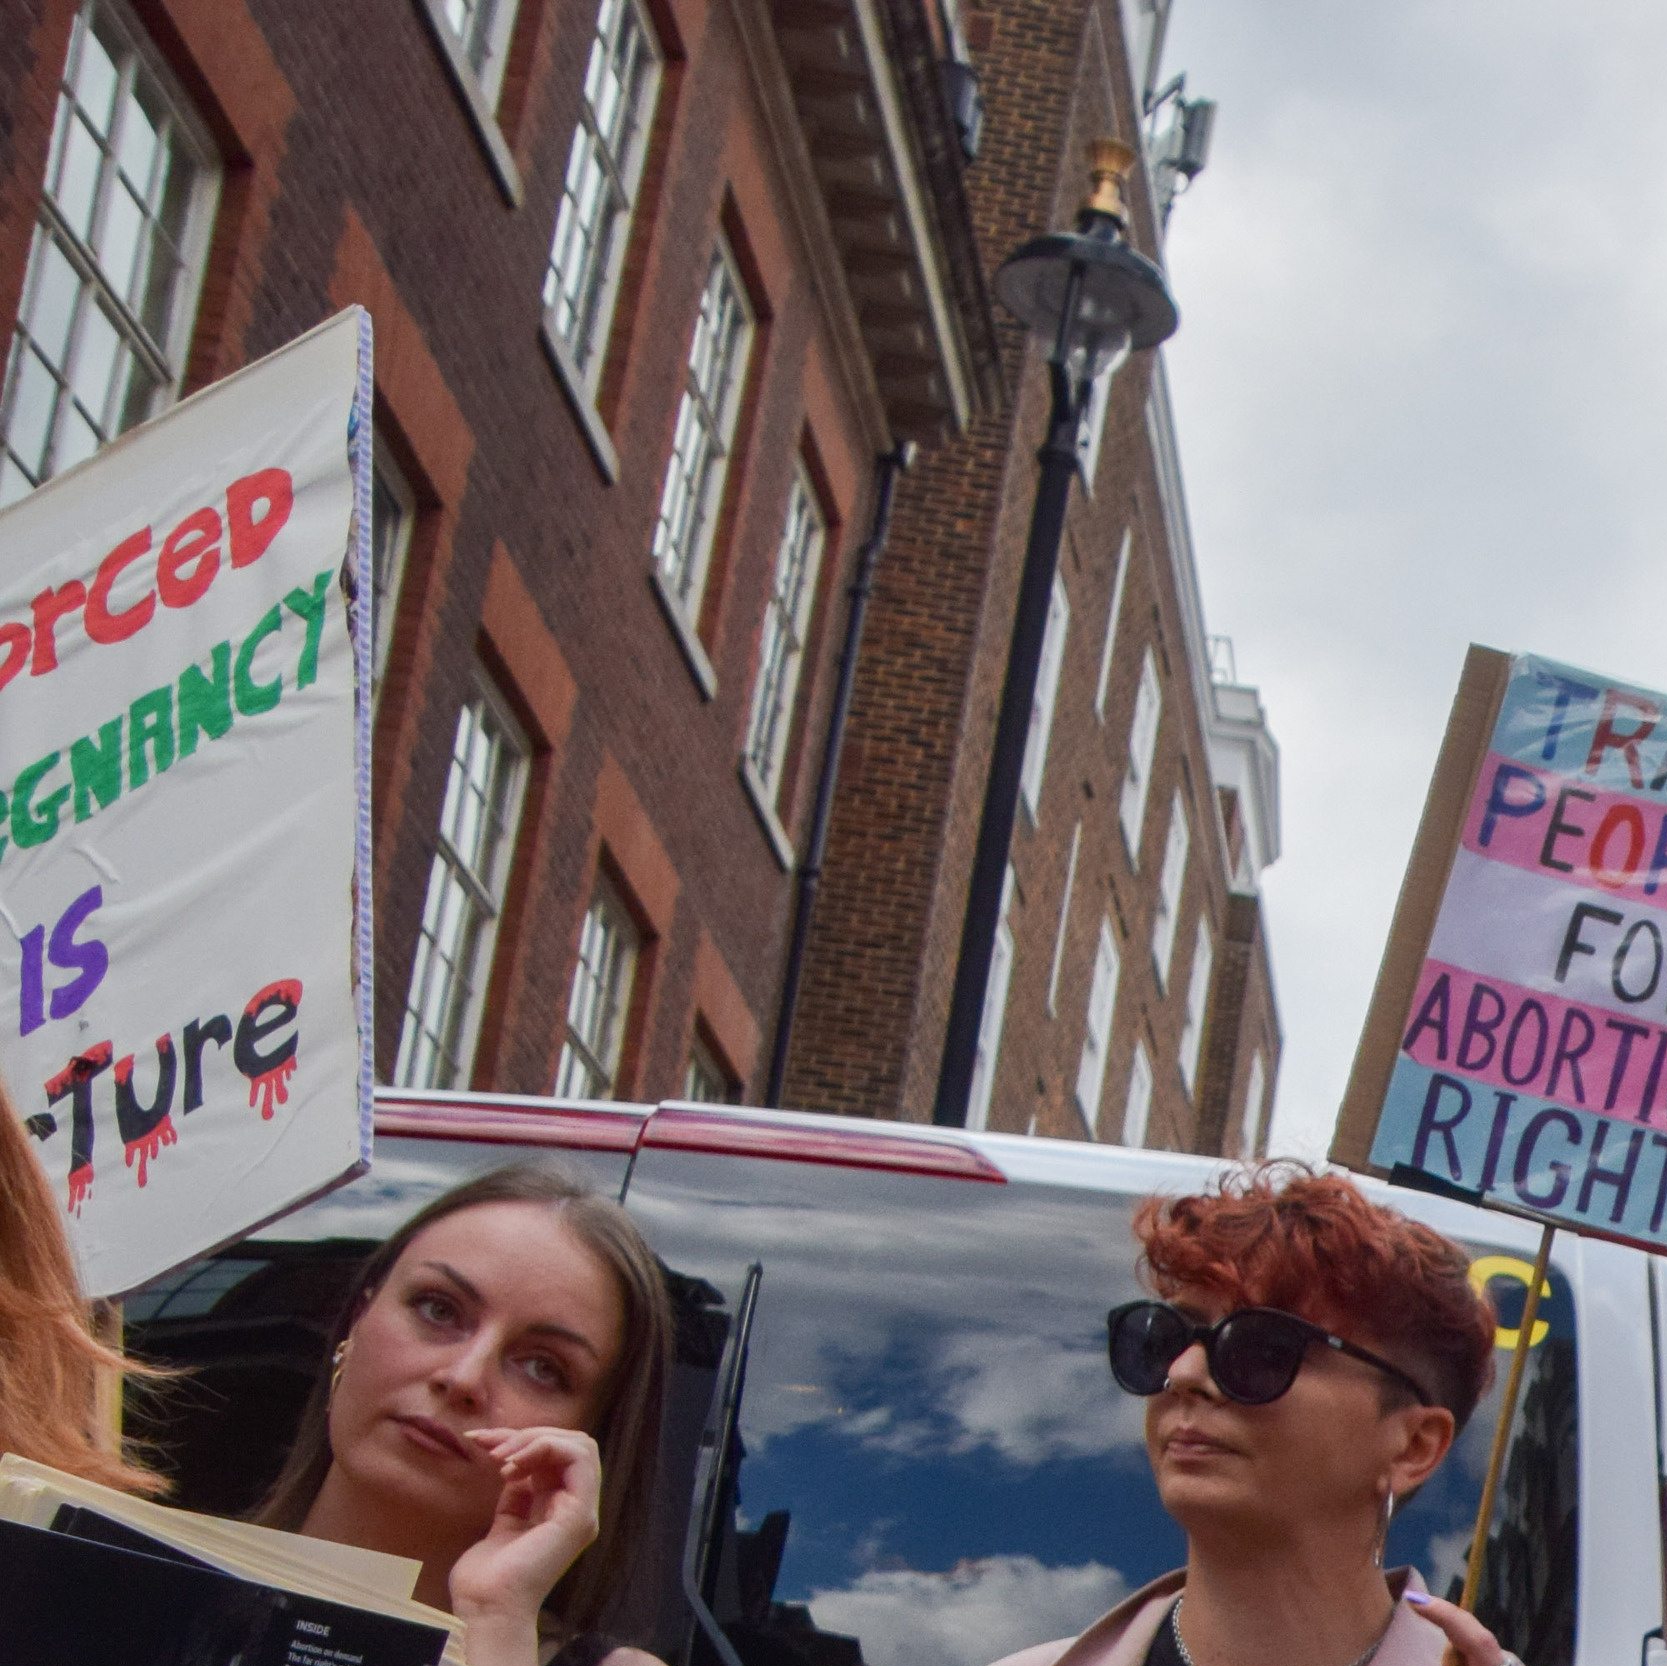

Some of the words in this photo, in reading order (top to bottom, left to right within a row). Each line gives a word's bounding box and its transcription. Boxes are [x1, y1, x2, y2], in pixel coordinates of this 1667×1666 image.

[0, 569, 335, 863] GNANCY
[19, 884, 109, 1037] IS
[290, 1640, 322, 1655] Abortion
[296, 1620, 331, 1637] INSIDE
